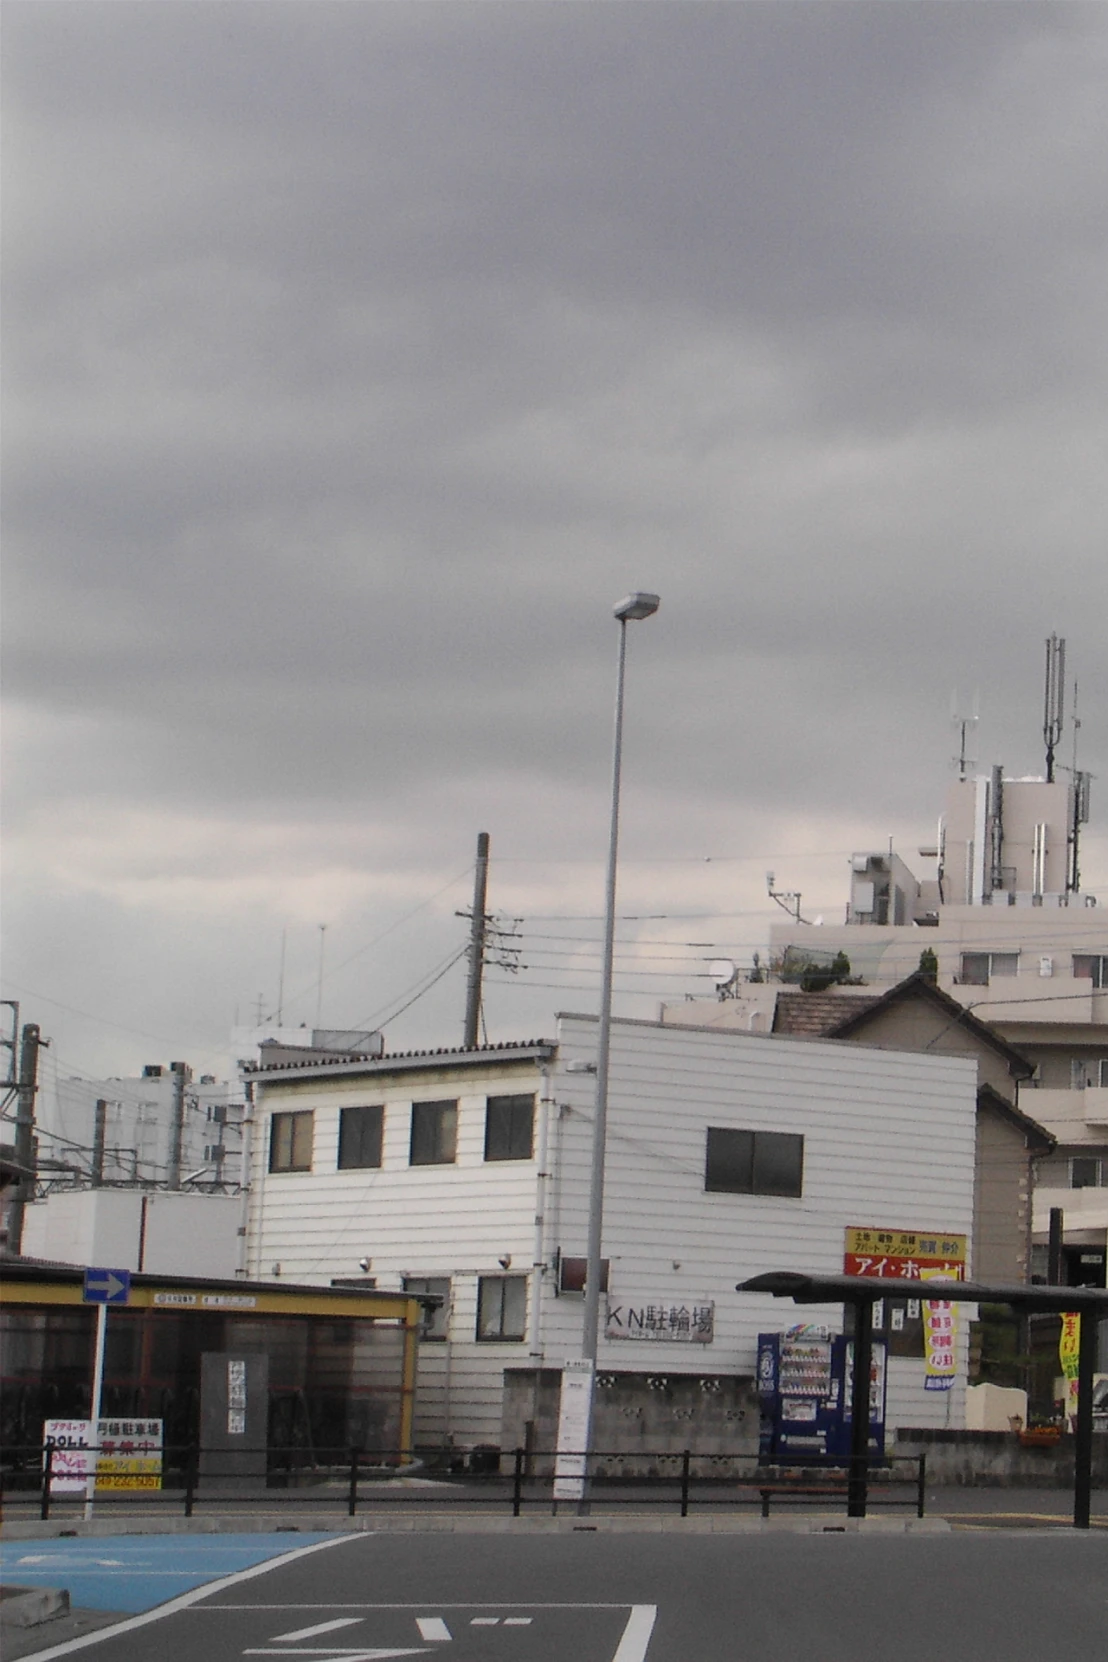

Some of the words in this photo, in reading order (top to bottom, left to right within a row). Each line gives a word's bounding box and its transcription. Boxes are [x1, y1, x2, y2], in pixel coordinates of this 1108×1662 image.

[855, 1242, 880, 1253] アパート
[885, 1244, 917, 1255] マンション
[855, 1257, 963, 1279] アイ・ホー
[97, 1422, 160, 1437] 月極駐車場
[46, 1435, 89, 1449] DOLL
